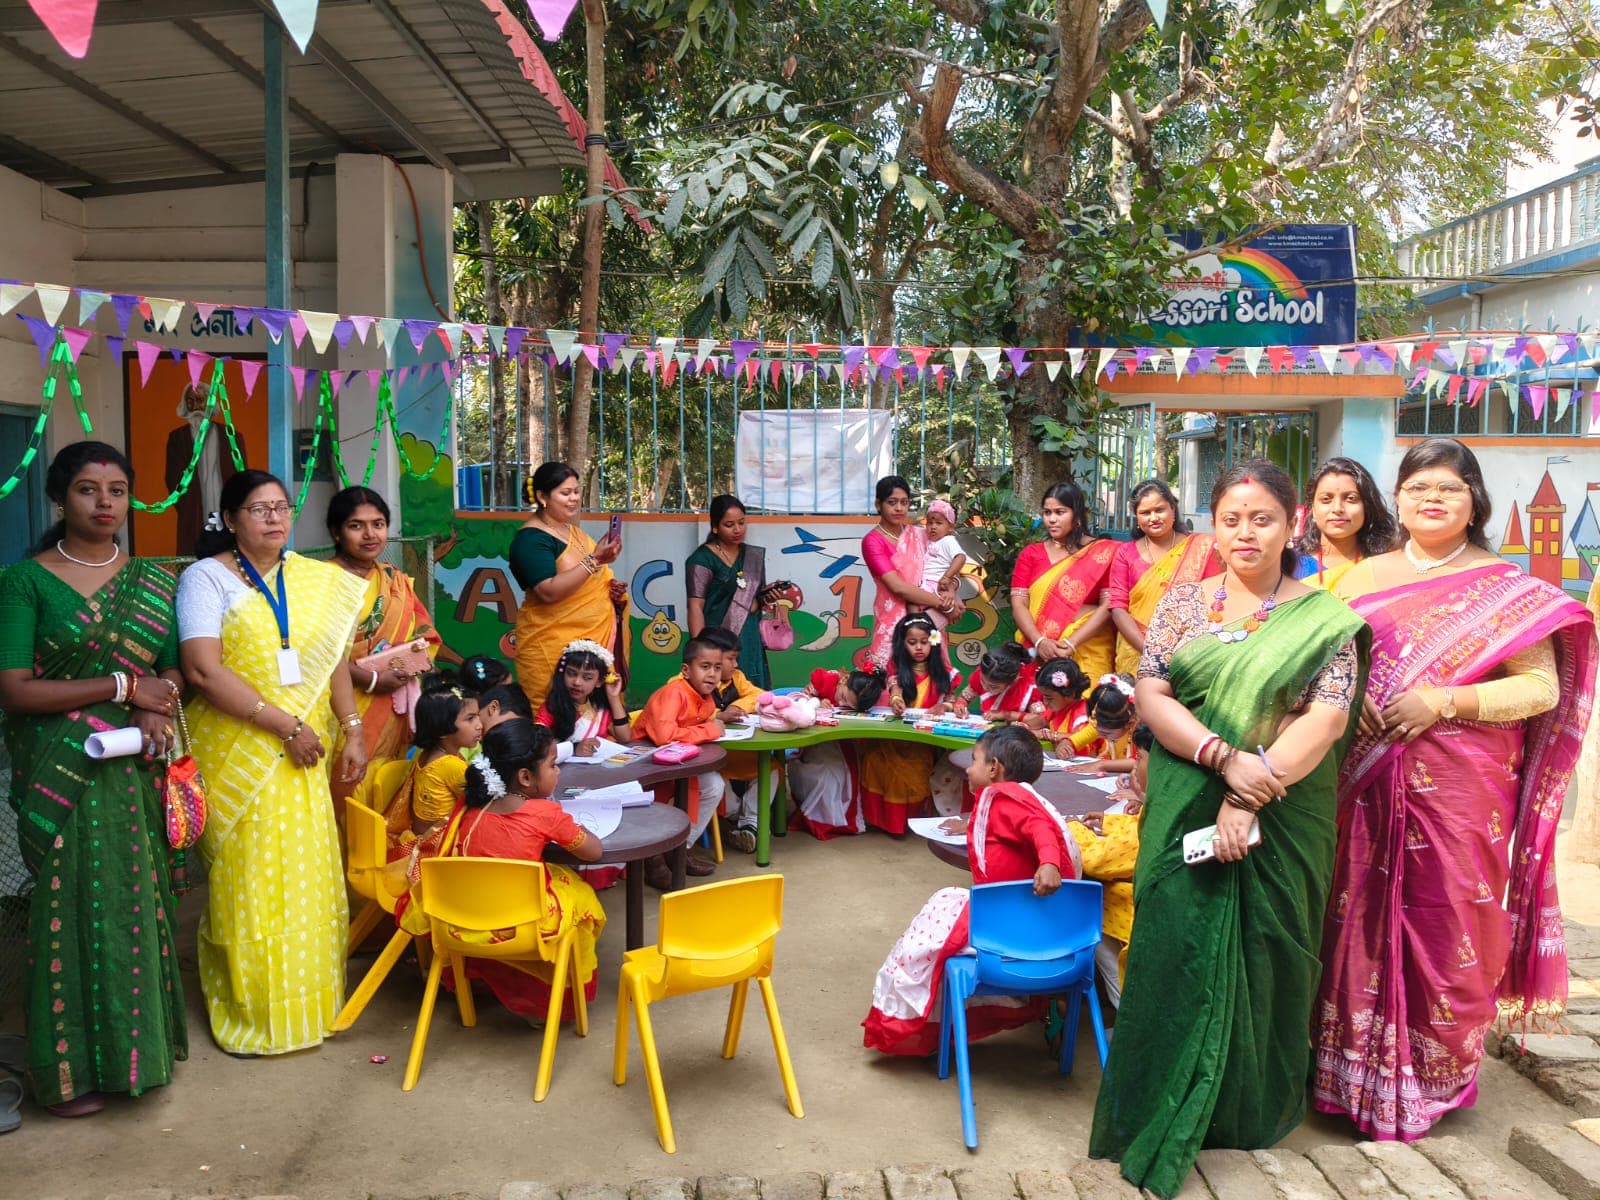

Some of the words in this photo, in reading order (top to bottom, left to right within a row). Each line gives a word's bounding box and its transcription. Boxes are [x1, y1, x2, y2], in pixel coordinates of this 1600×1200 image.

[1234, 288, 1325, 326] School
[455, 567, 518, 624] A
[632, 559, 676, 622] C
[830, 575, 871, 639] 1
